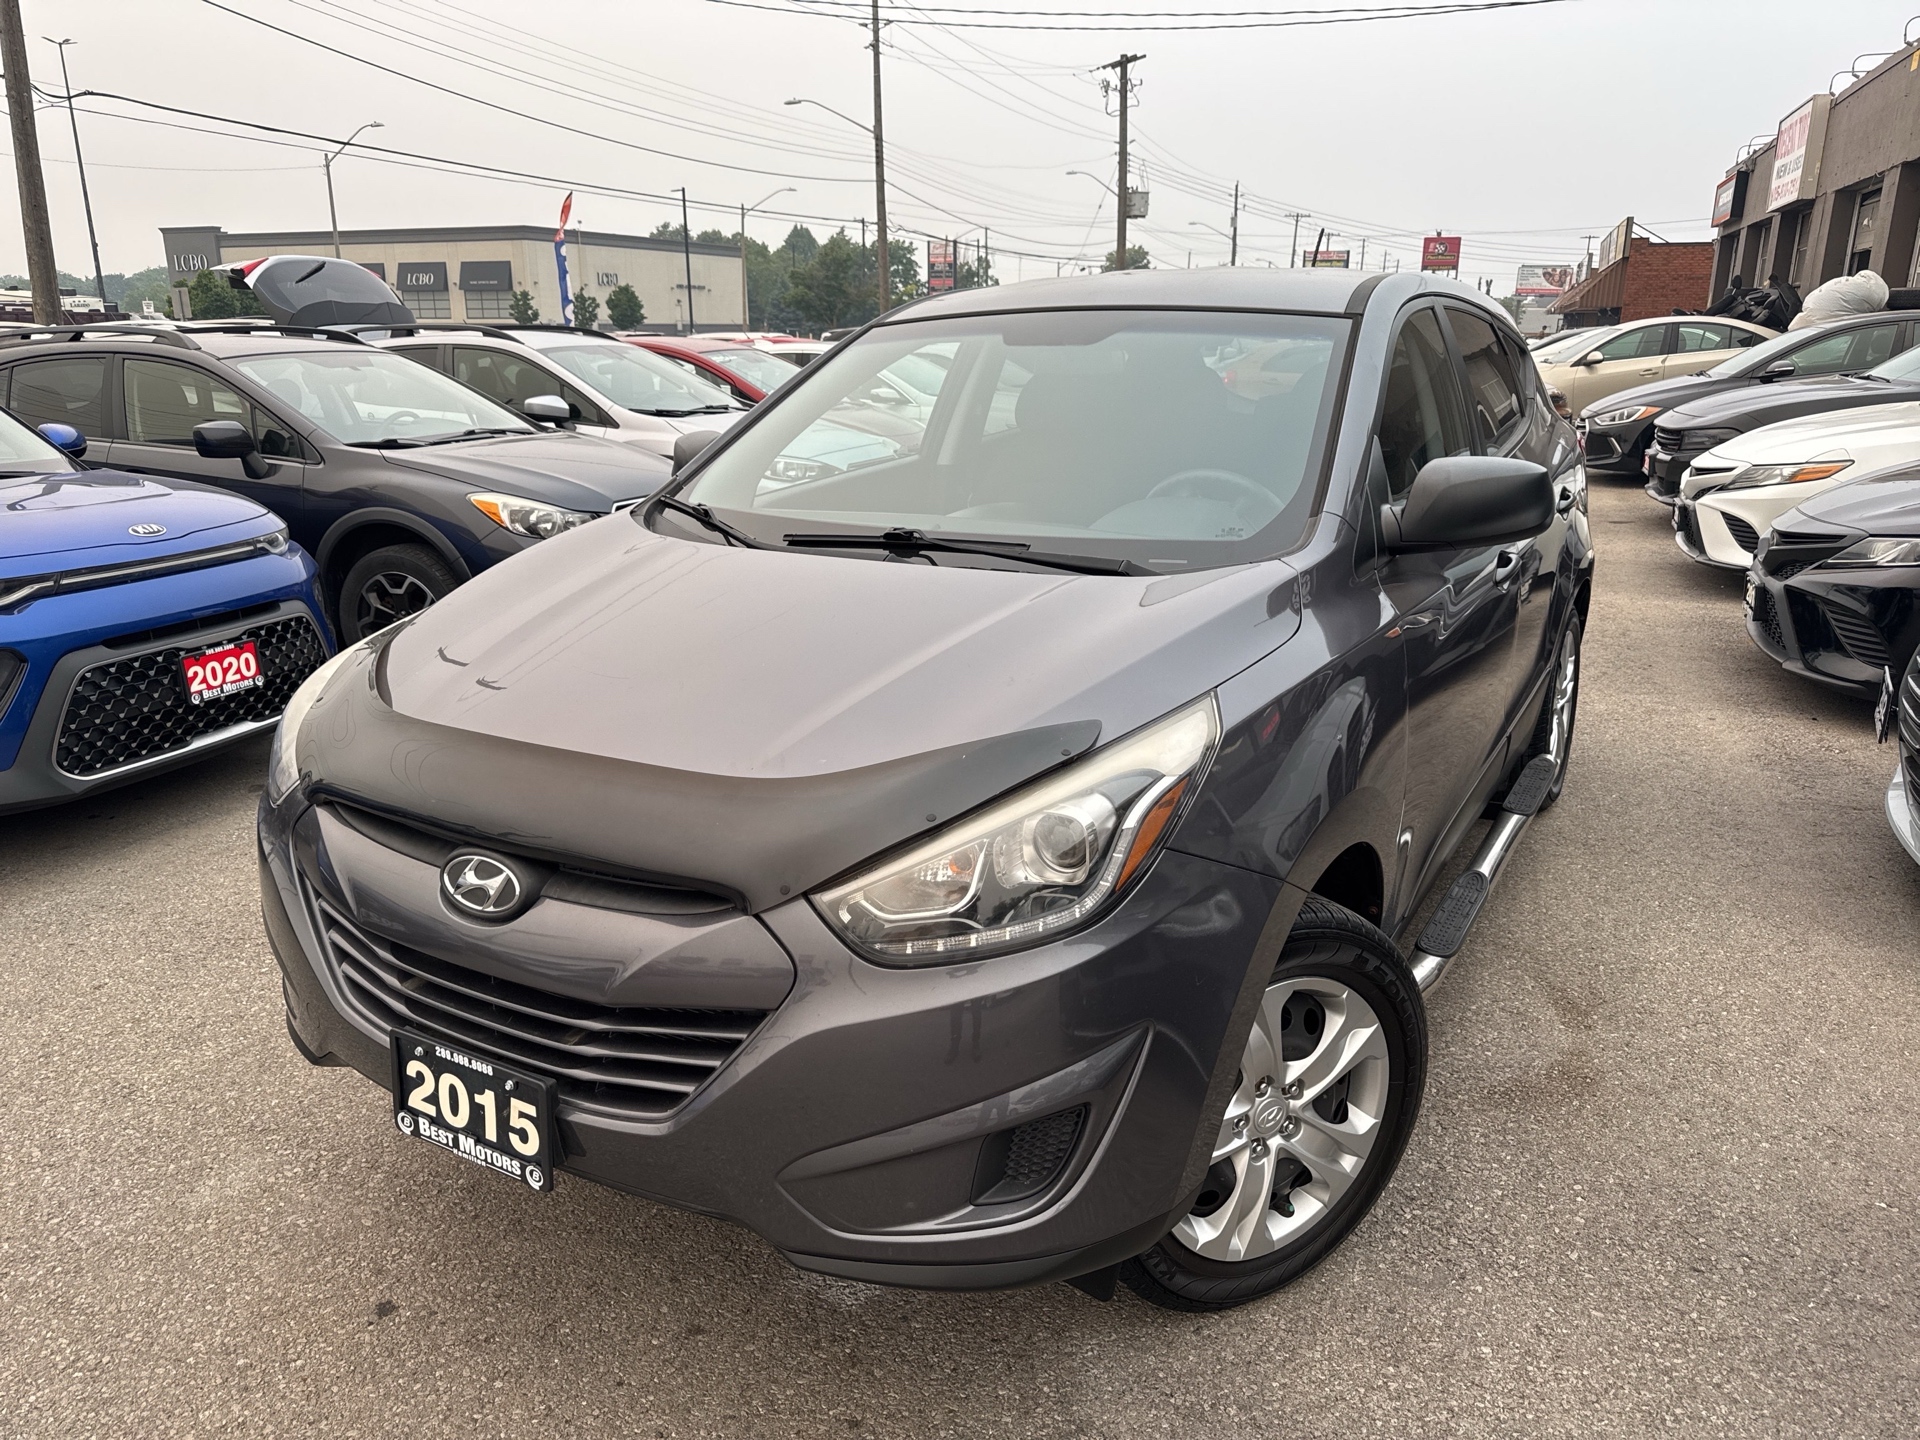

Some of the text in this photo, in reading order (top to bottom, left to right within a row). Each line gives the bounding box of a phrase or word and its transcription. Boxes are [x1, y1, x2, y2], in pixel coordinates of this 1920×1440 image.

[1775, 162, 1789, 181] NEW
[173, 254, 208, 271] LCBO
[407, 273, 434, 285] LCBO
[596, 272, 619, 286] LCBO
[131, 523, 164, 534] KIA
[187, 652, 257, 693] 2020
[202, 687, 222, 700] BEST
[222, 678, 254, 693] MOTORS
[435, 1046, 493, 1076] 289.988.8088
[406, 1060, 540, 1157] 2015
[418, 1116, 522, 1176] BEST MOTORS
